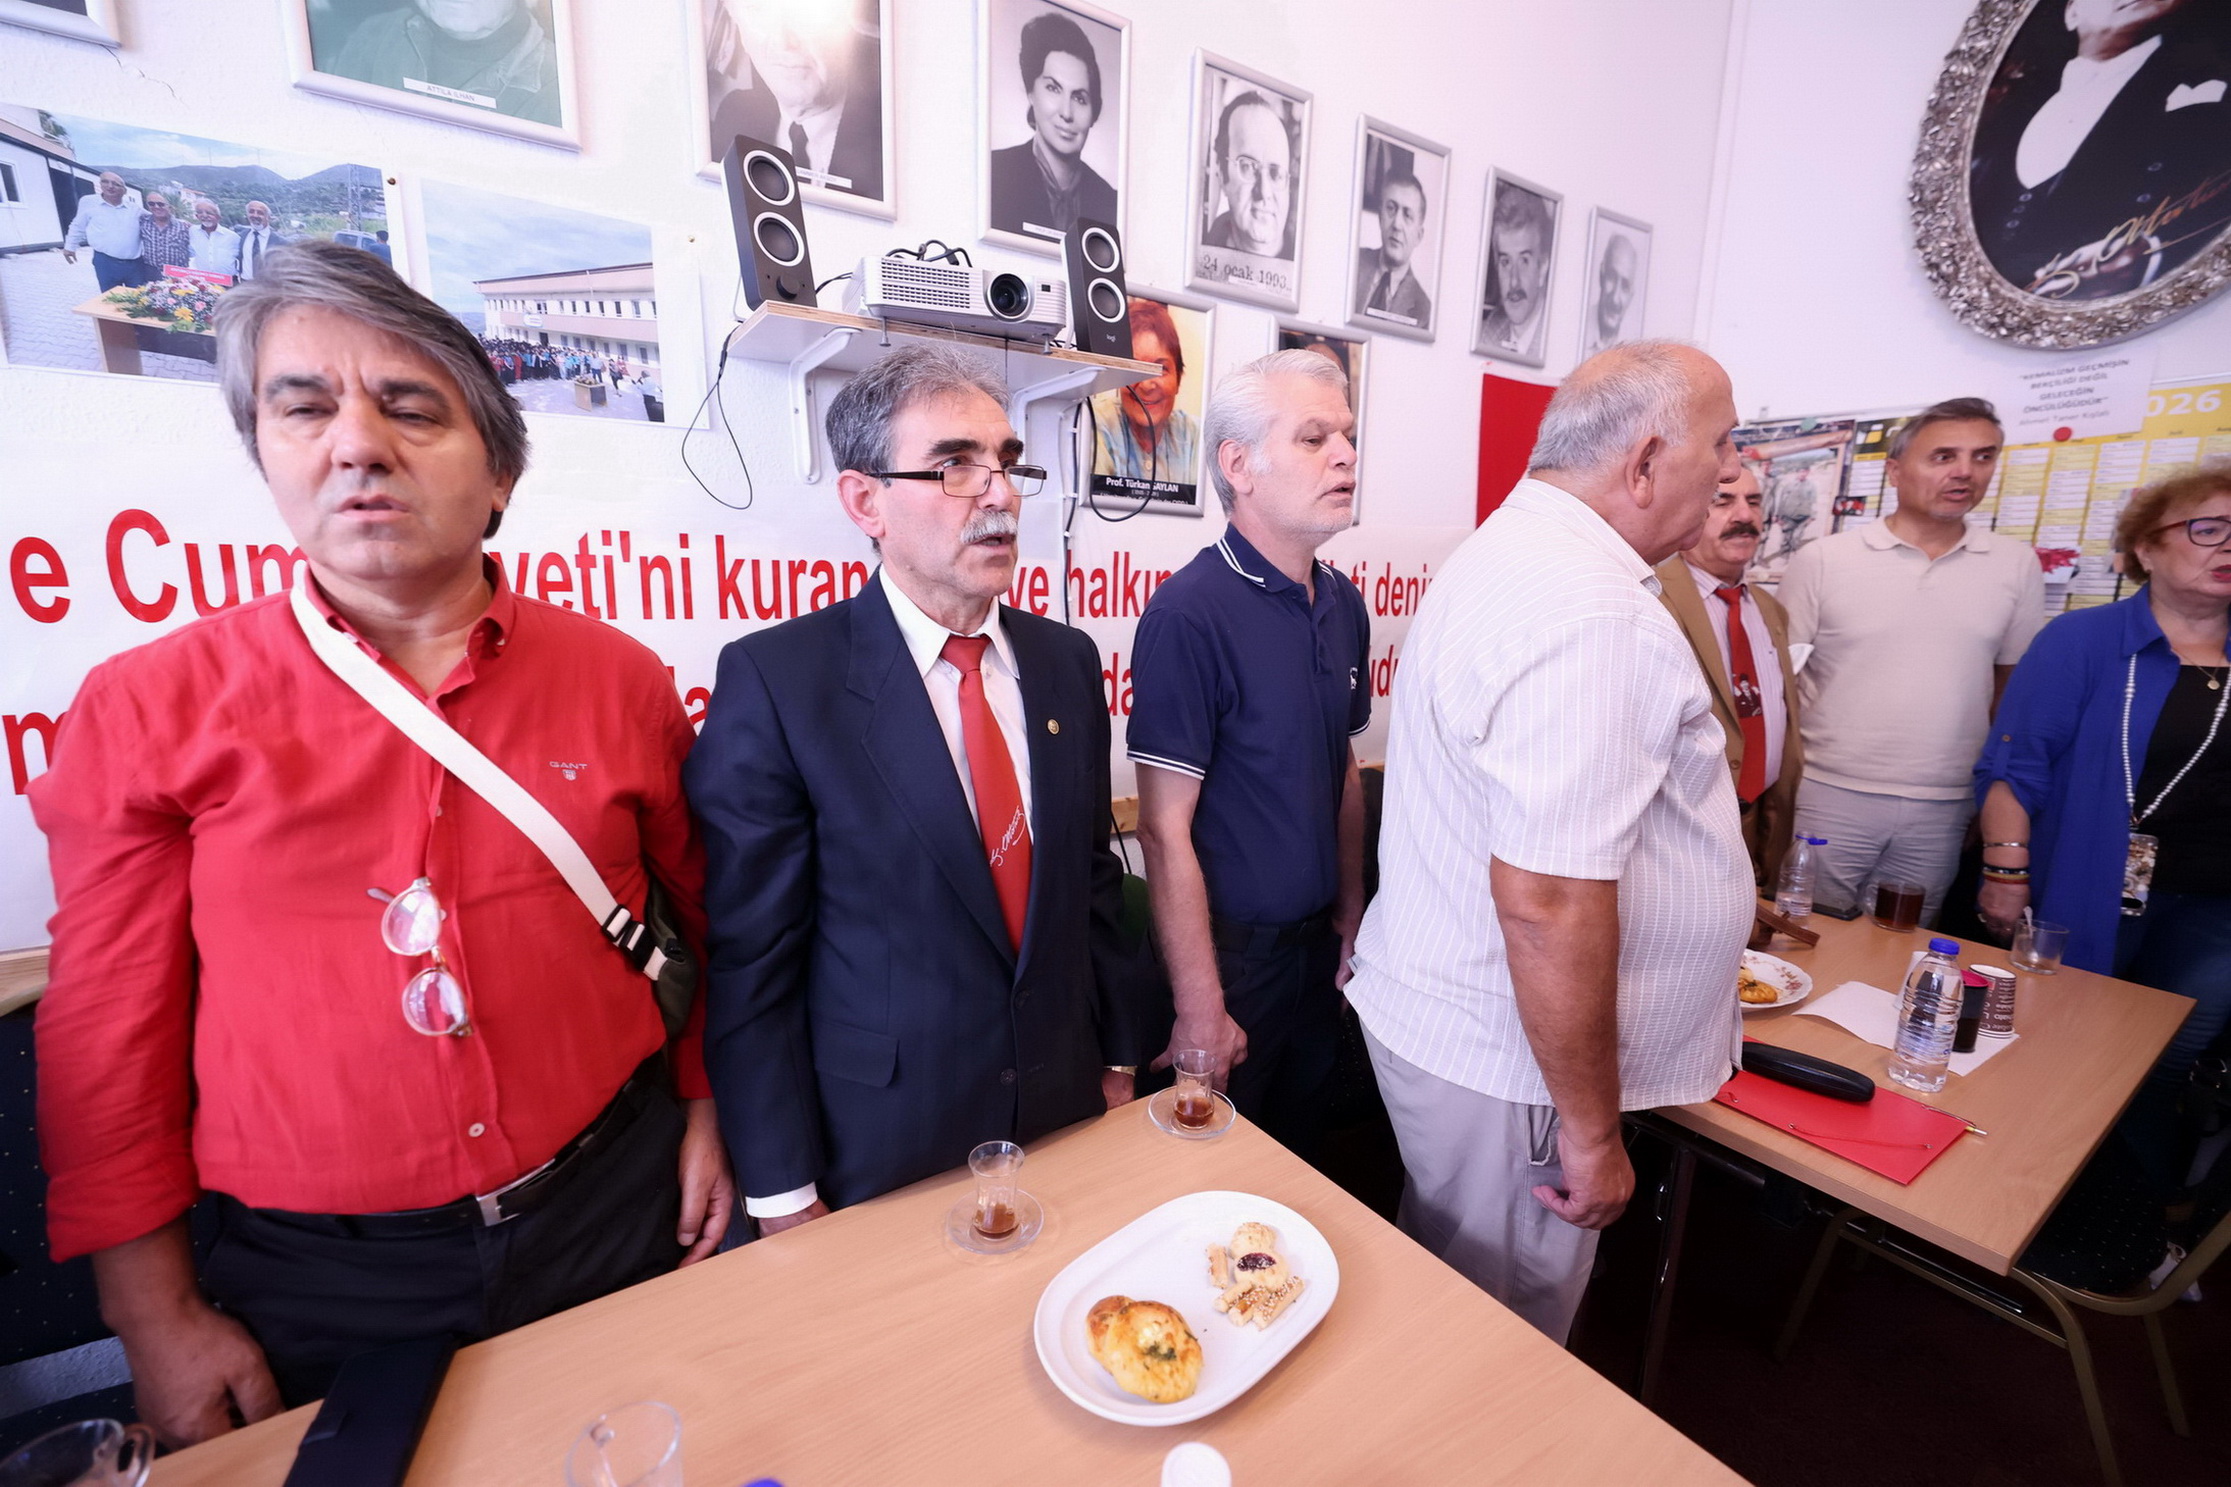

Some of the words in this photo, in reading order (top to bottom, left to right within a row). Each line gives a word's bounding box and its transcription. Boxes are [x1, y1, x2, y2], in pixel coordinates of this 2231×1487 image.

[1203, 254, 1218, 272] 24
[2146, 389, 2222, 417] 026
[1106, 477, 1124, 488] Prof.
[549, 761, 588, 770] GANT
